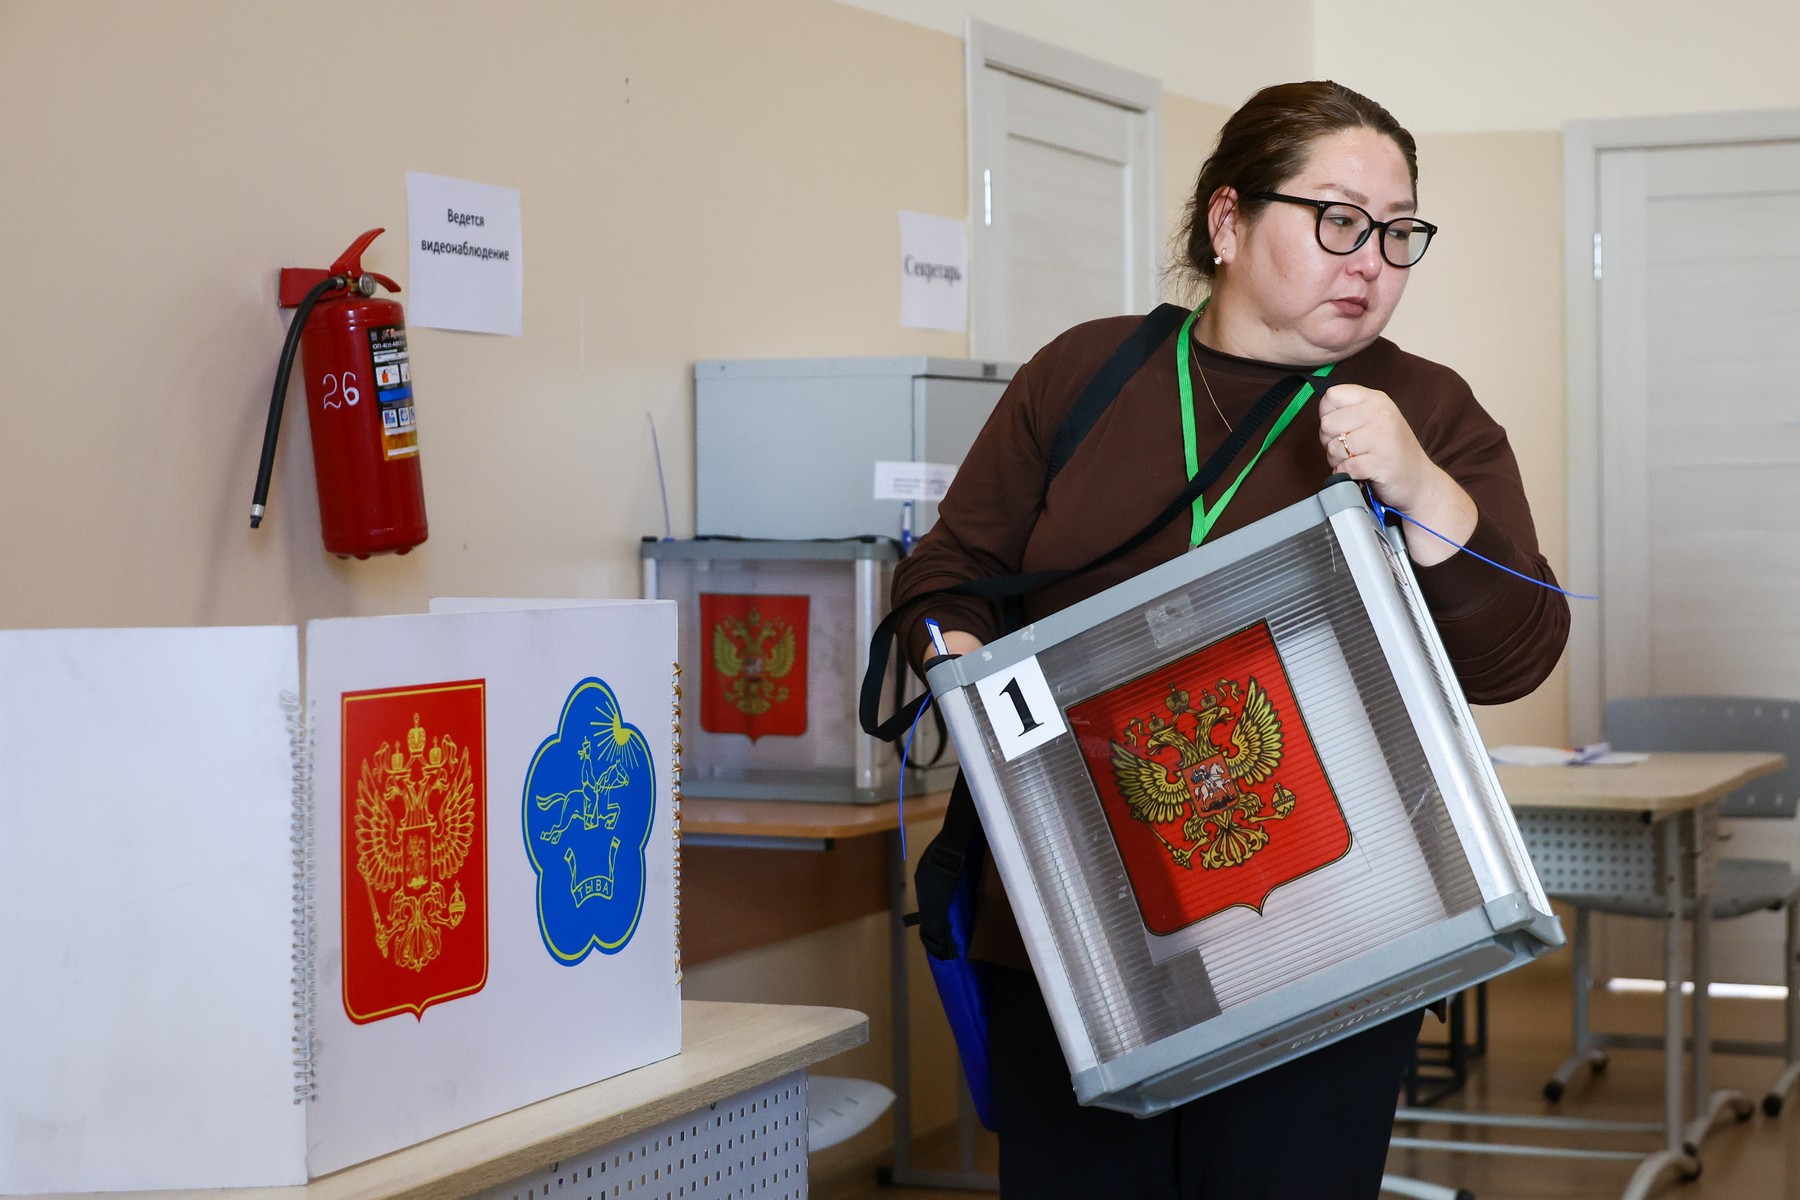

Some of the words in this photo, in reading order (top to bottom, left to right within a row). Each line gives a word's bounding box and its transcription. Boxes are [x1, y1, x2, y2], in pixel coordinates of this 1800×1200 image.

[447, 208, 485, 227] Ведется
[421, 239, 510, 261] видеонаблюдение
[904, 253, 962, 287] Секретарь
[323, 371, 360, 410] 26
[999, 676, 1044, 737] 1
[577, 879, 609, 899] ТЫВА
